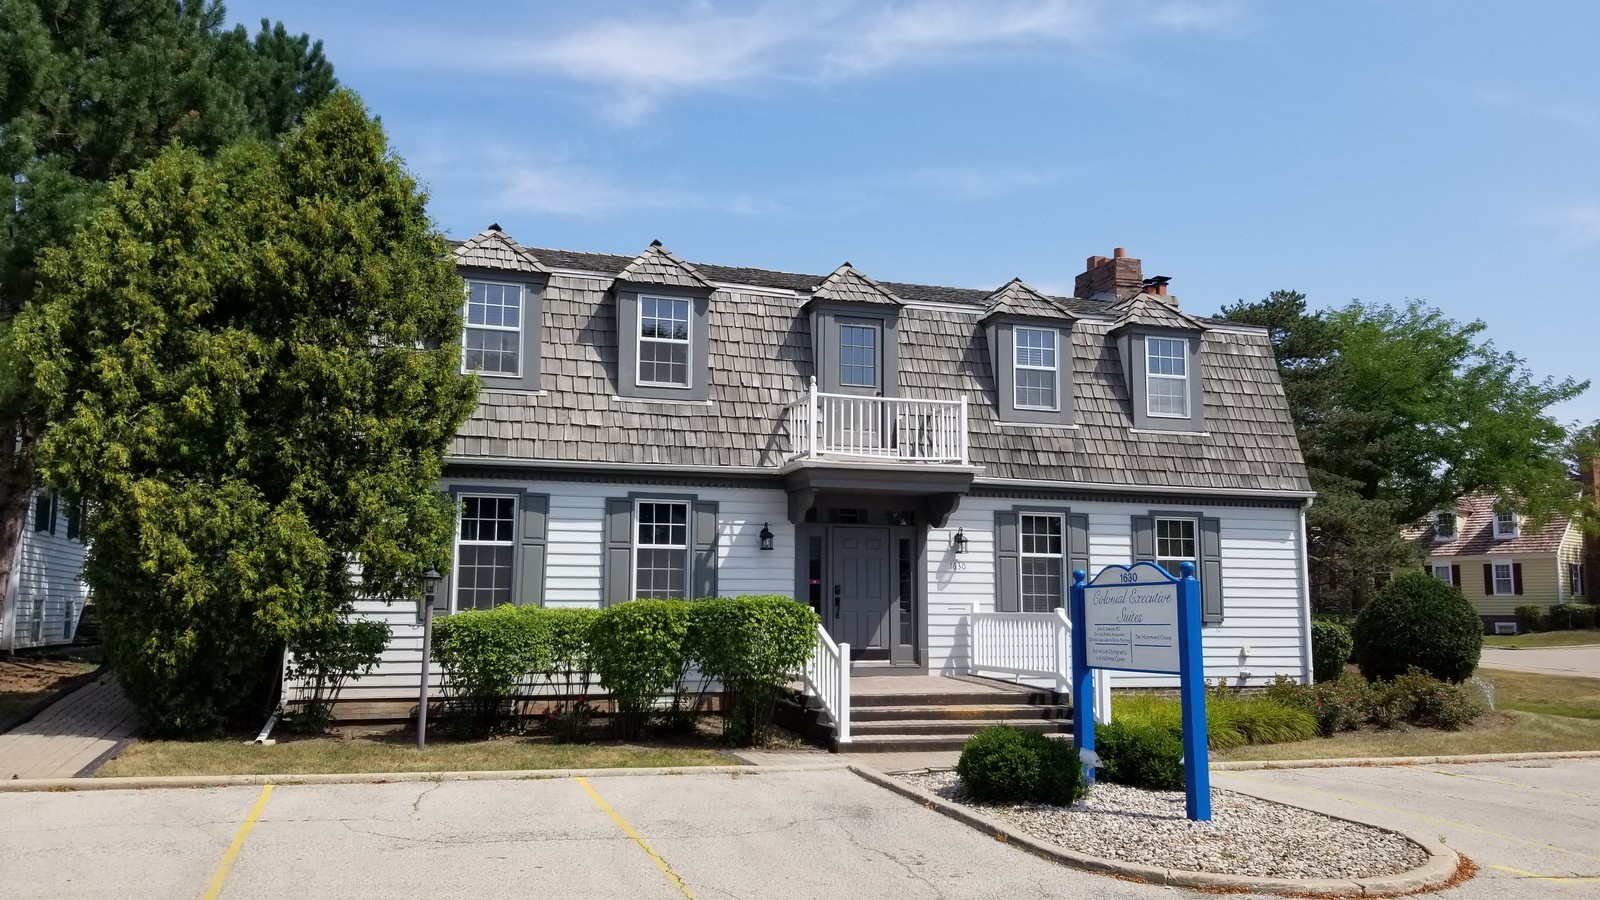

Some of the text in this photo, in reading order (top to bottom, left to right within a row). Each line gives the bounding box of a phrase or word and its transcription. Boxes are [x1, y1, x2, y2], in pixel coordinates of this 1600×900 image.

[950, 562, 967, 571] 1630
[1119, 572, 1138, 583] 1630
[1093, 588, 1173, 606] Colonial Executive
[1116, 607, 1143, 623] Suites
